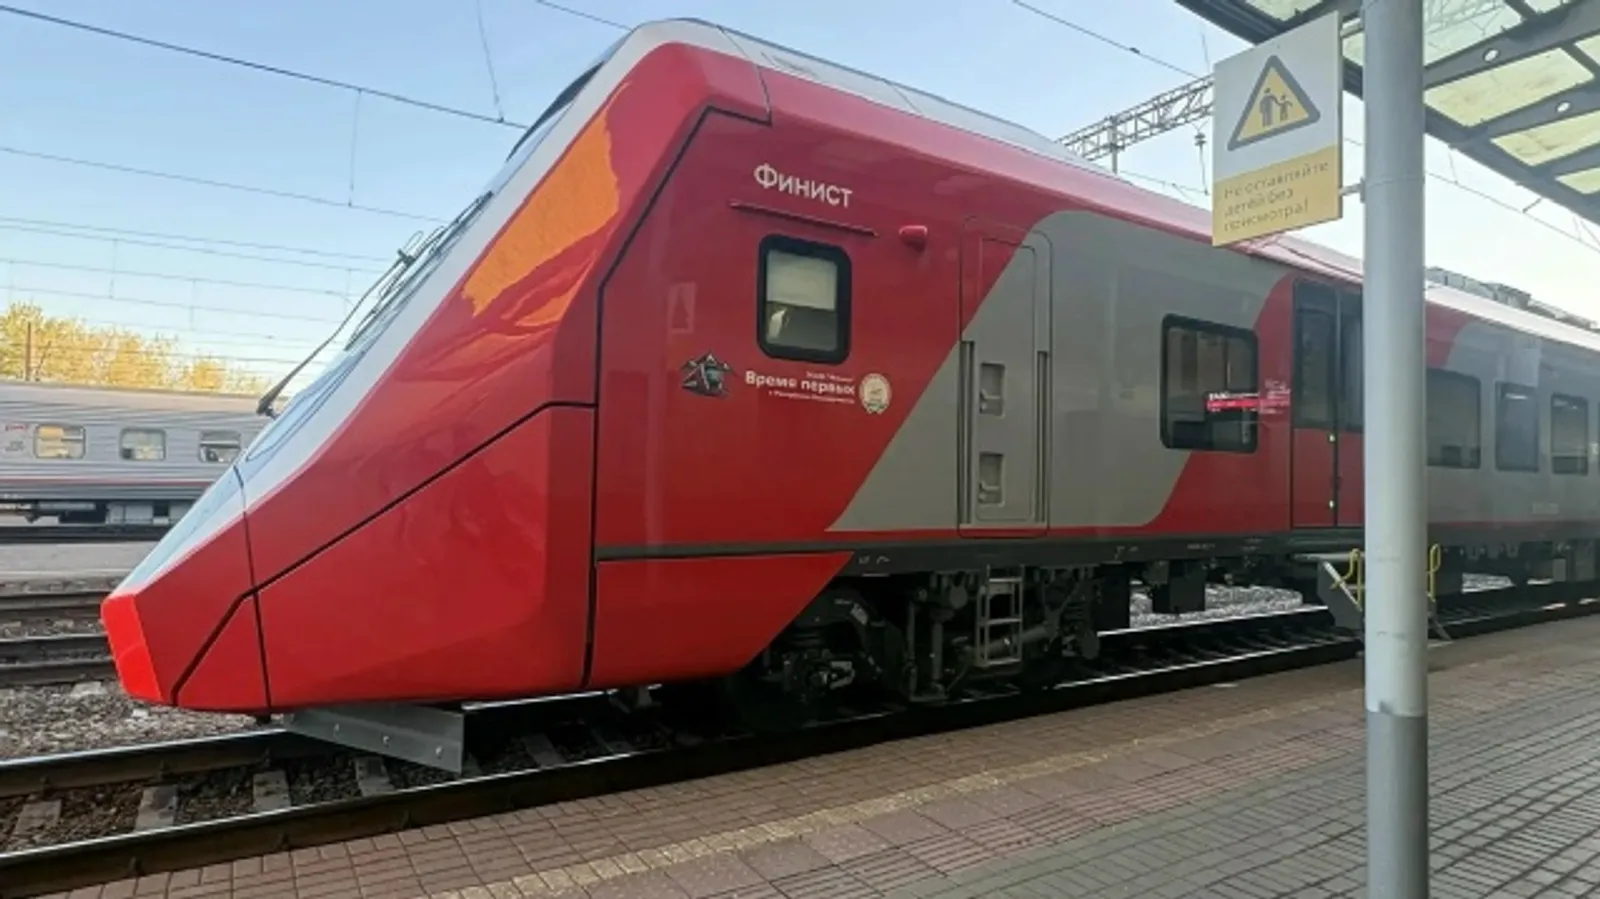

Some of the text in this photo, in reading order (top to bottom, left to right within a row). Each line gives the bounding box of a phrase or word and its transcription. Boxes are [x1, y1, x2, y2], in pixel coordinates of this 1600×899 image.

[753, 163, 853, 208] Финист
[1224, 187, 1242, 199] Не
[745, 371, 797, 387] Время
[801, 379, 855, 395] первых
